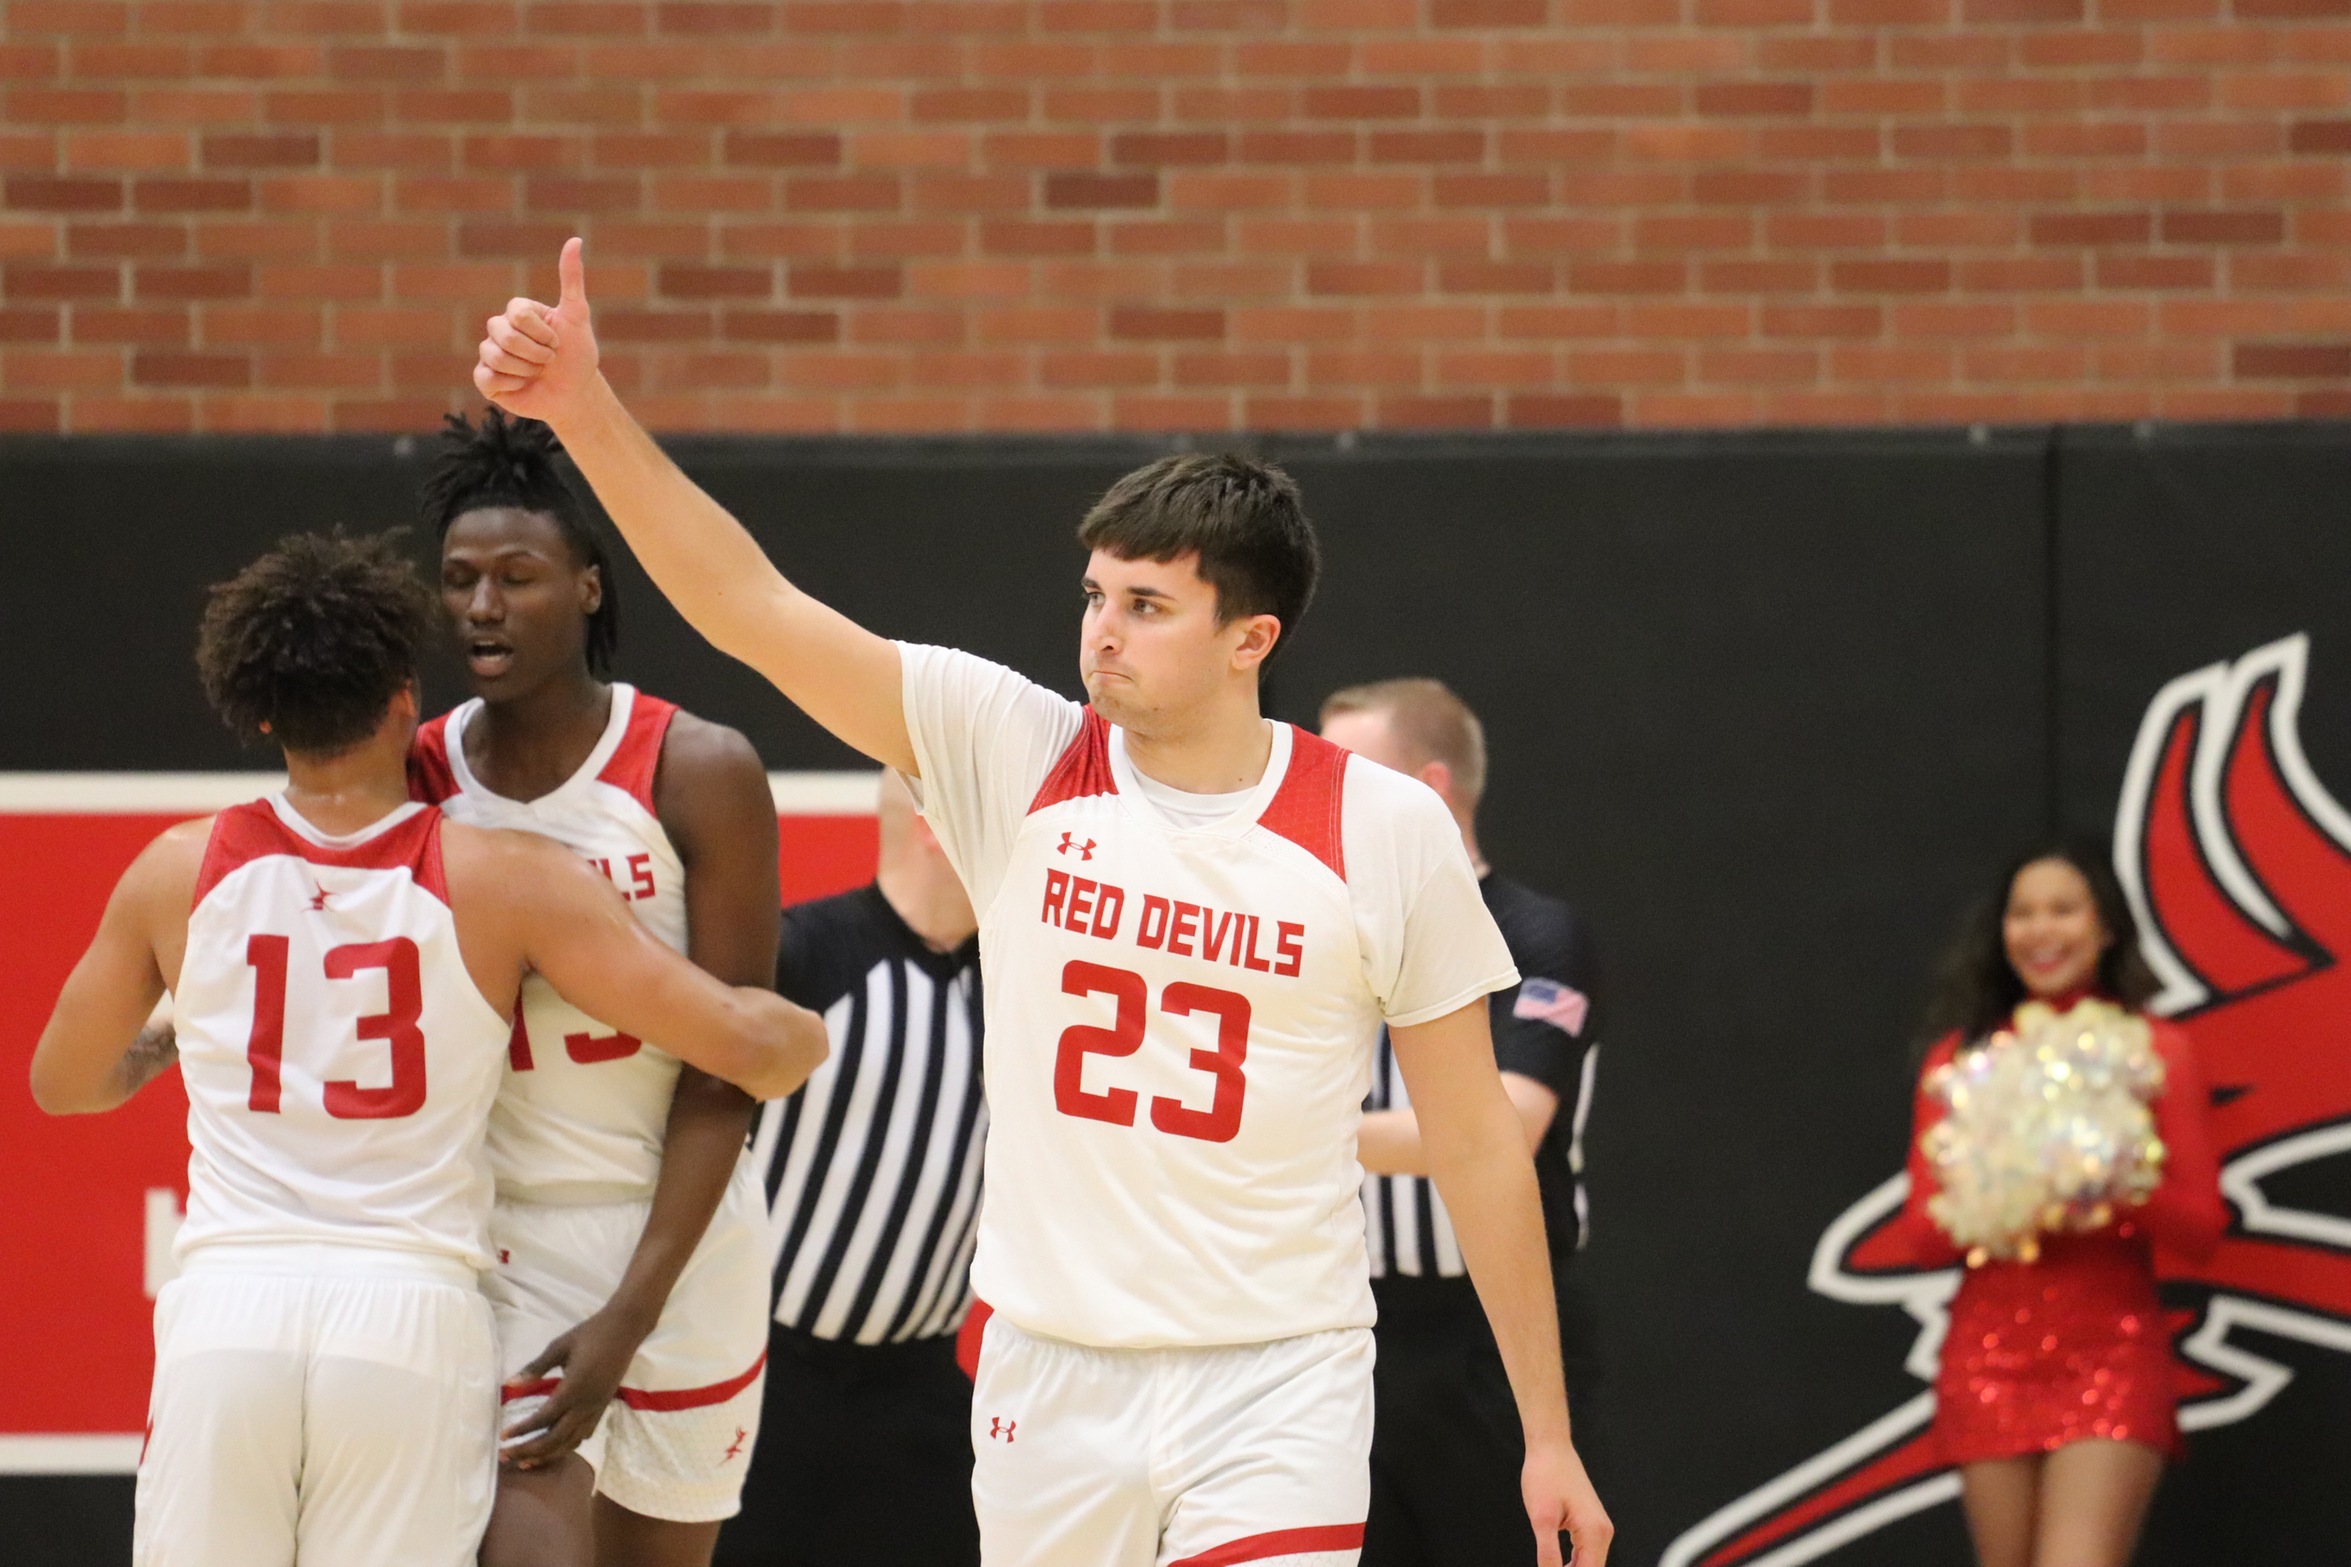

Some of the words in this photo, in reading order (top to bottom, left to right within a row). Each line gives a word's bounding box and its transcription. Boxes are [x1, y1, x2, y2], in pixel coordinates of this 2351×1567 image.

[1041, 868, 1125, 941] RED
[1136, 893, 1305, 978] DEVILS
[246, 933, 427, 1120] 13
[1053, 959, 1252, 1143] 23
